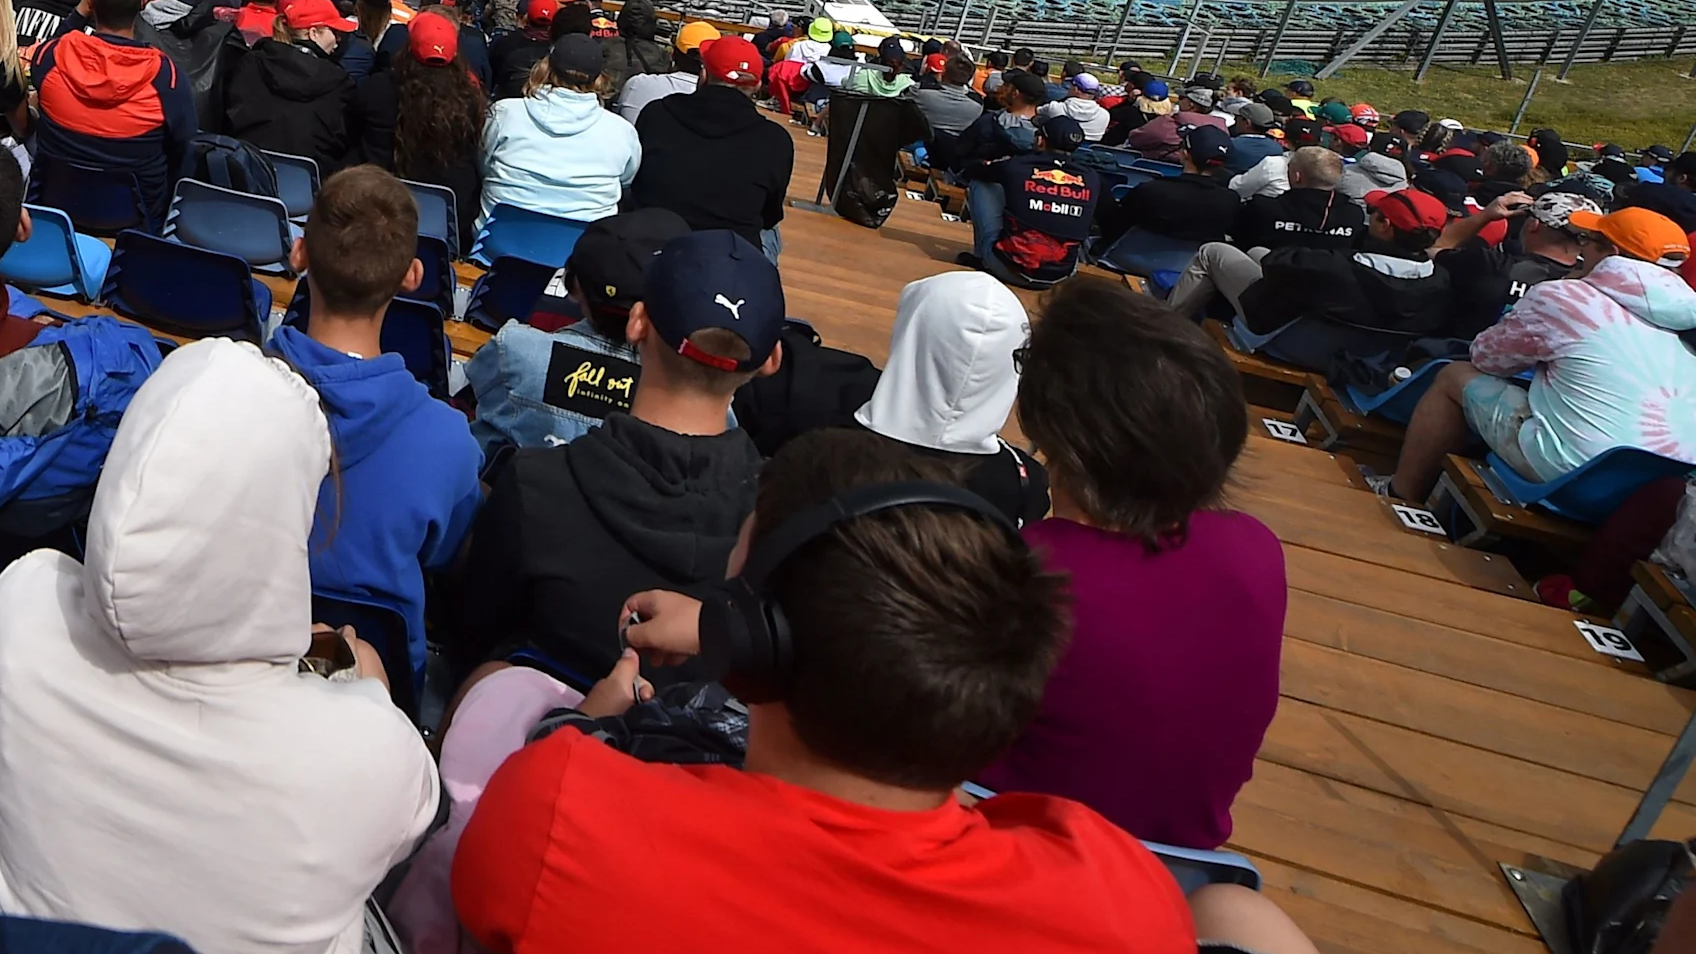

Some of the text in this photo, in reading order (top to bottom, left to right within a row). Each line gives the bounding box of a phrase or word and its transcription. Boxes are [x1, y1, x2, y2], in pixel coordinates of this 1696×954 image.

[1024, 180, 1090, 201] Red Bull
[1029, 199, 1069, 215] Mobil
[564, 362, 634, 398] fall out
[577, 389, 630, 408] infinity on
[1268, 422, 1298, 438] 17
[1398, 509, 1440, 529] 18
[1582, 627, 1633, 652] 19
